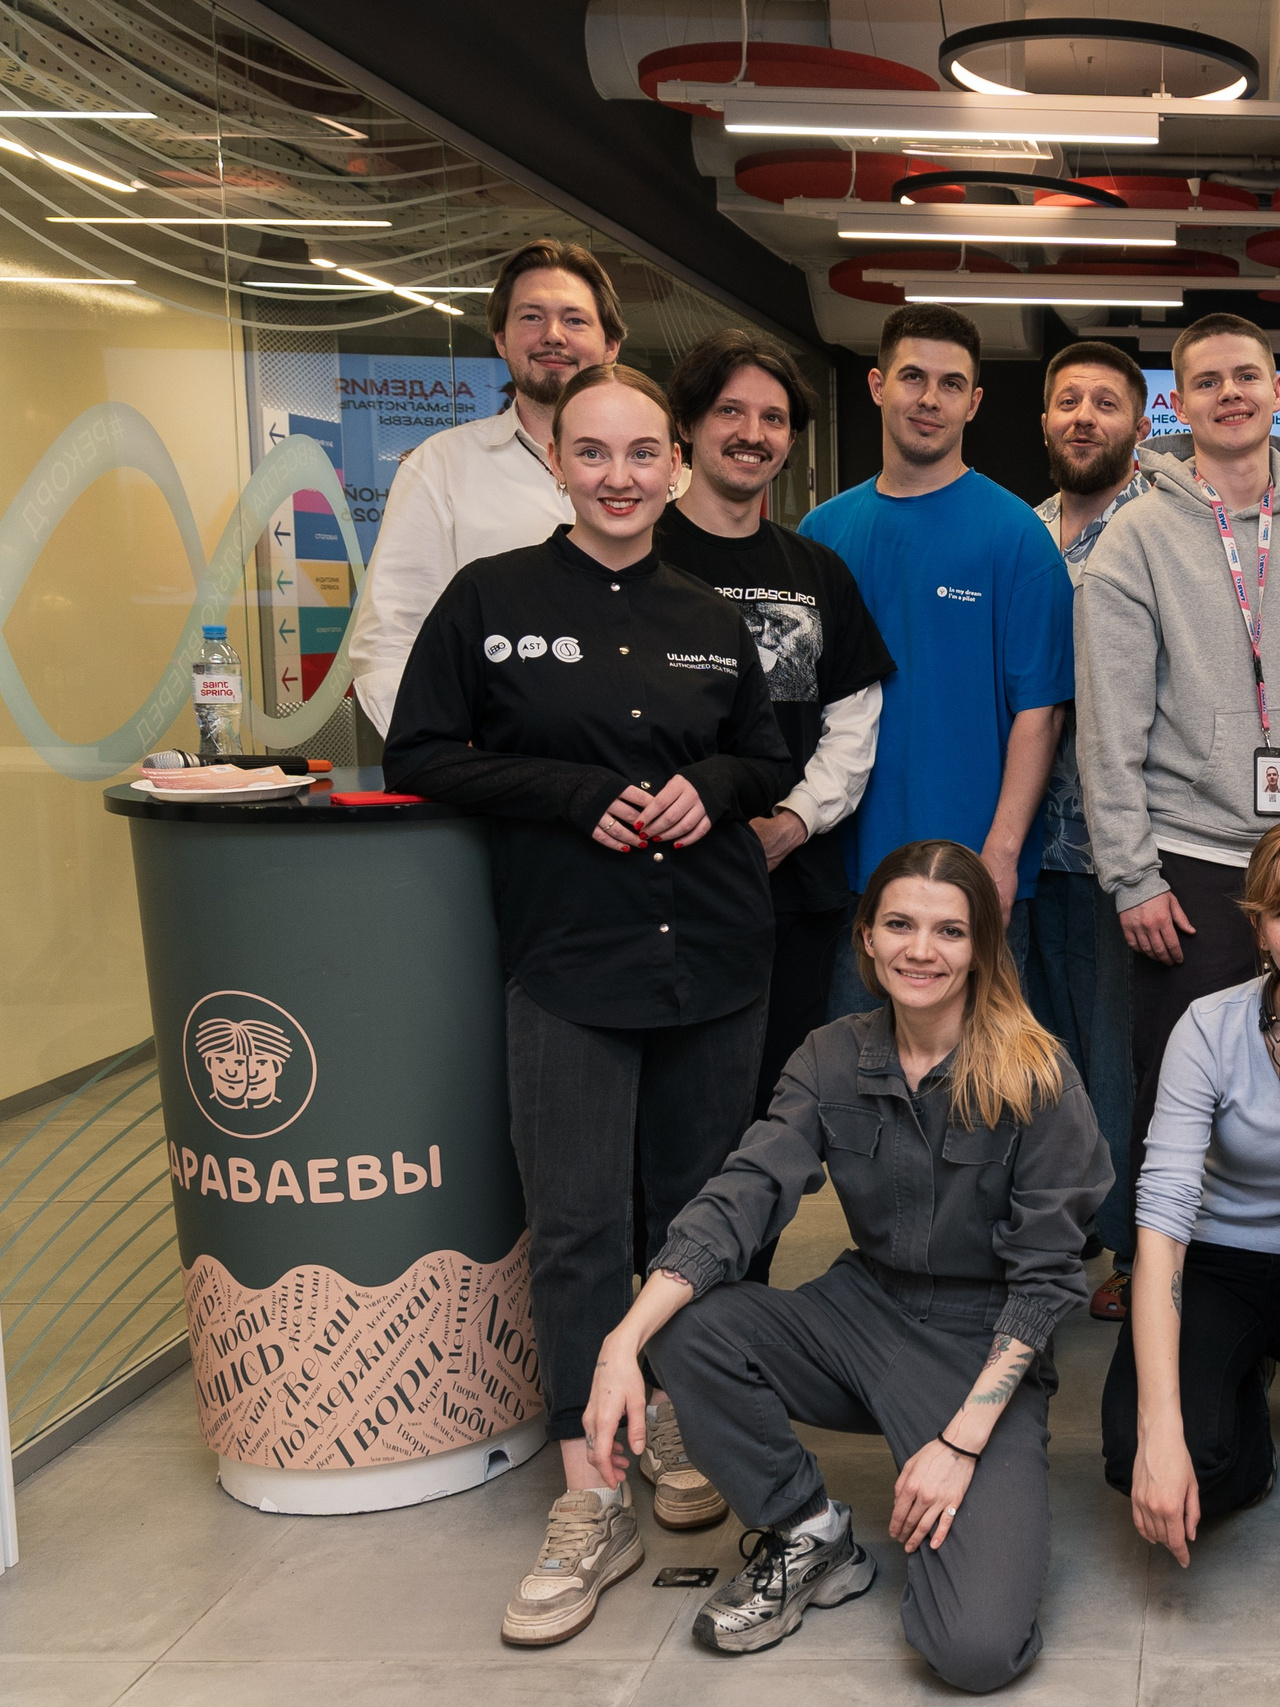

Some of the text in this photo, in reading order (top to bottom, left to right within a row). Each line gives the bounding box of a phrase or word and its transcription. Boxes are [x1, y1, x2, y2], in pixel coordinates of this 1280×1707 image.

[745, 588, 816, 606] OBSCURA
[523, 642, 541, 651] AST
[666, 653, 738, 667] ULIANA ASHER
[669, 662, 711, 670] AUTHORIZED
[200, 689, 234, 697] SPRING
[202, 681, 229, 689] saint
[288, 1271, 305, 1353] Желай
[306, 1269, 320, 1328] Желай
[446, 1265, 473, 1374] Мечтай
[210, 1305, 271, 1362] Люби
[419, 1301, 442, 1344] Желай
[271, 1274, 441, 1469] Поддерживай
[276, 1291, 361, 1419] Желай
[325, 1339, 444, 1468] Твори
[418, 1377, 443, 1414] Верь
[452, 1380, 481, 1402] Твори
[467, 1351, 525, 1421] Учись
[233, 1386, 273, 1462] Желай
[432, 1391, 495, 1438] Люби
[396, 1421, 432, 1457] Твори
